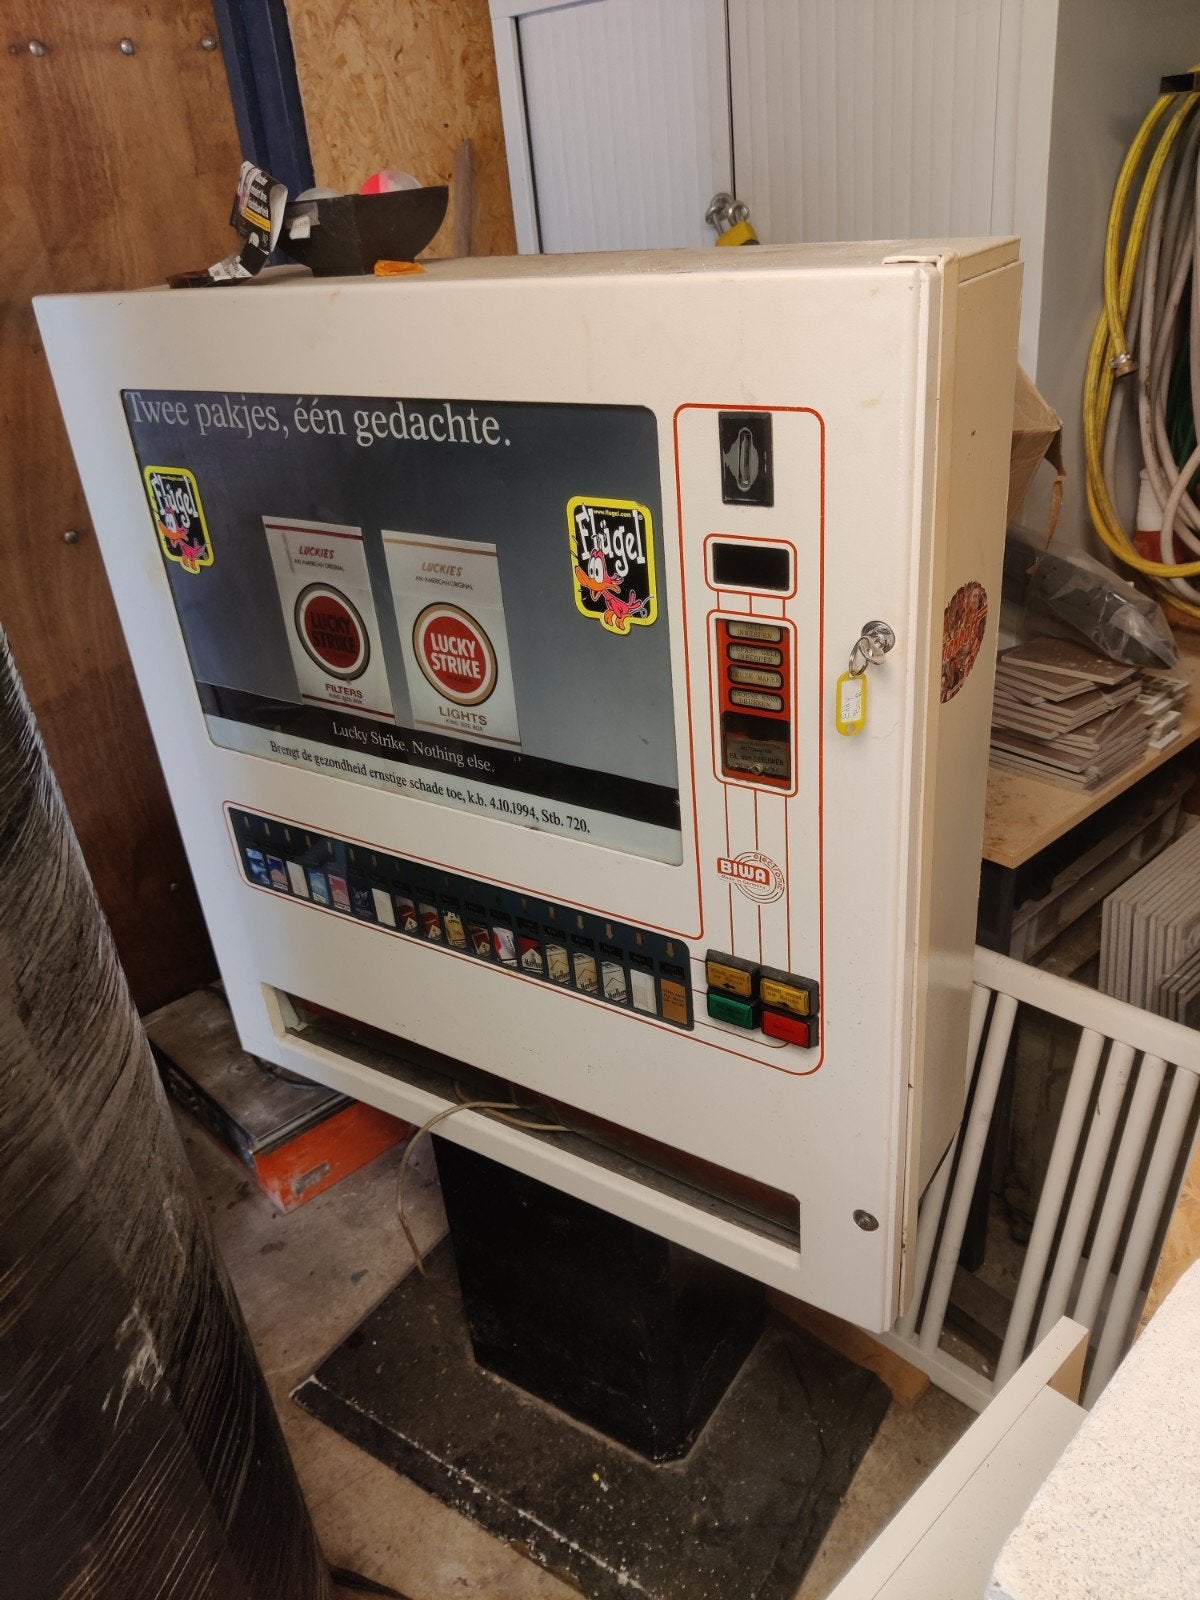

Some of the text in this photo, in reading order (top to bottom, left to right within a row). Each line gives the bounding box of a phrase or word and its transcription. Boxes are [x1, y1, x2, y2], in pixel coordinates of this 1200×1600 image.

[124, 391, 512, 447] Twee pakjes, één gedachte.
[299, 545, 335, 560] LUCKIES
[575, 503, 646, 577] Flügel
[422, 562, 463, 577] LUCKIES
[310, 611, 350, 633] LUCKY
[311, 630, 357, 654] STRIKE
[430, 632, 476, 658] LUCKY
[431, 652, 482, 679] STRIKE
[325, 683, 363, 699] FILTERS
[438, 706, 488, 726] LIGHTS
[332, 722, 495, 773] Lucky Strike. Nothing else.
[269, 740, 591, 834] Brengt de gezondheid ernstige schade toe, k.b. 4.10.1994, Stb. 720.
[719, 858, 768, 885] BIWA
